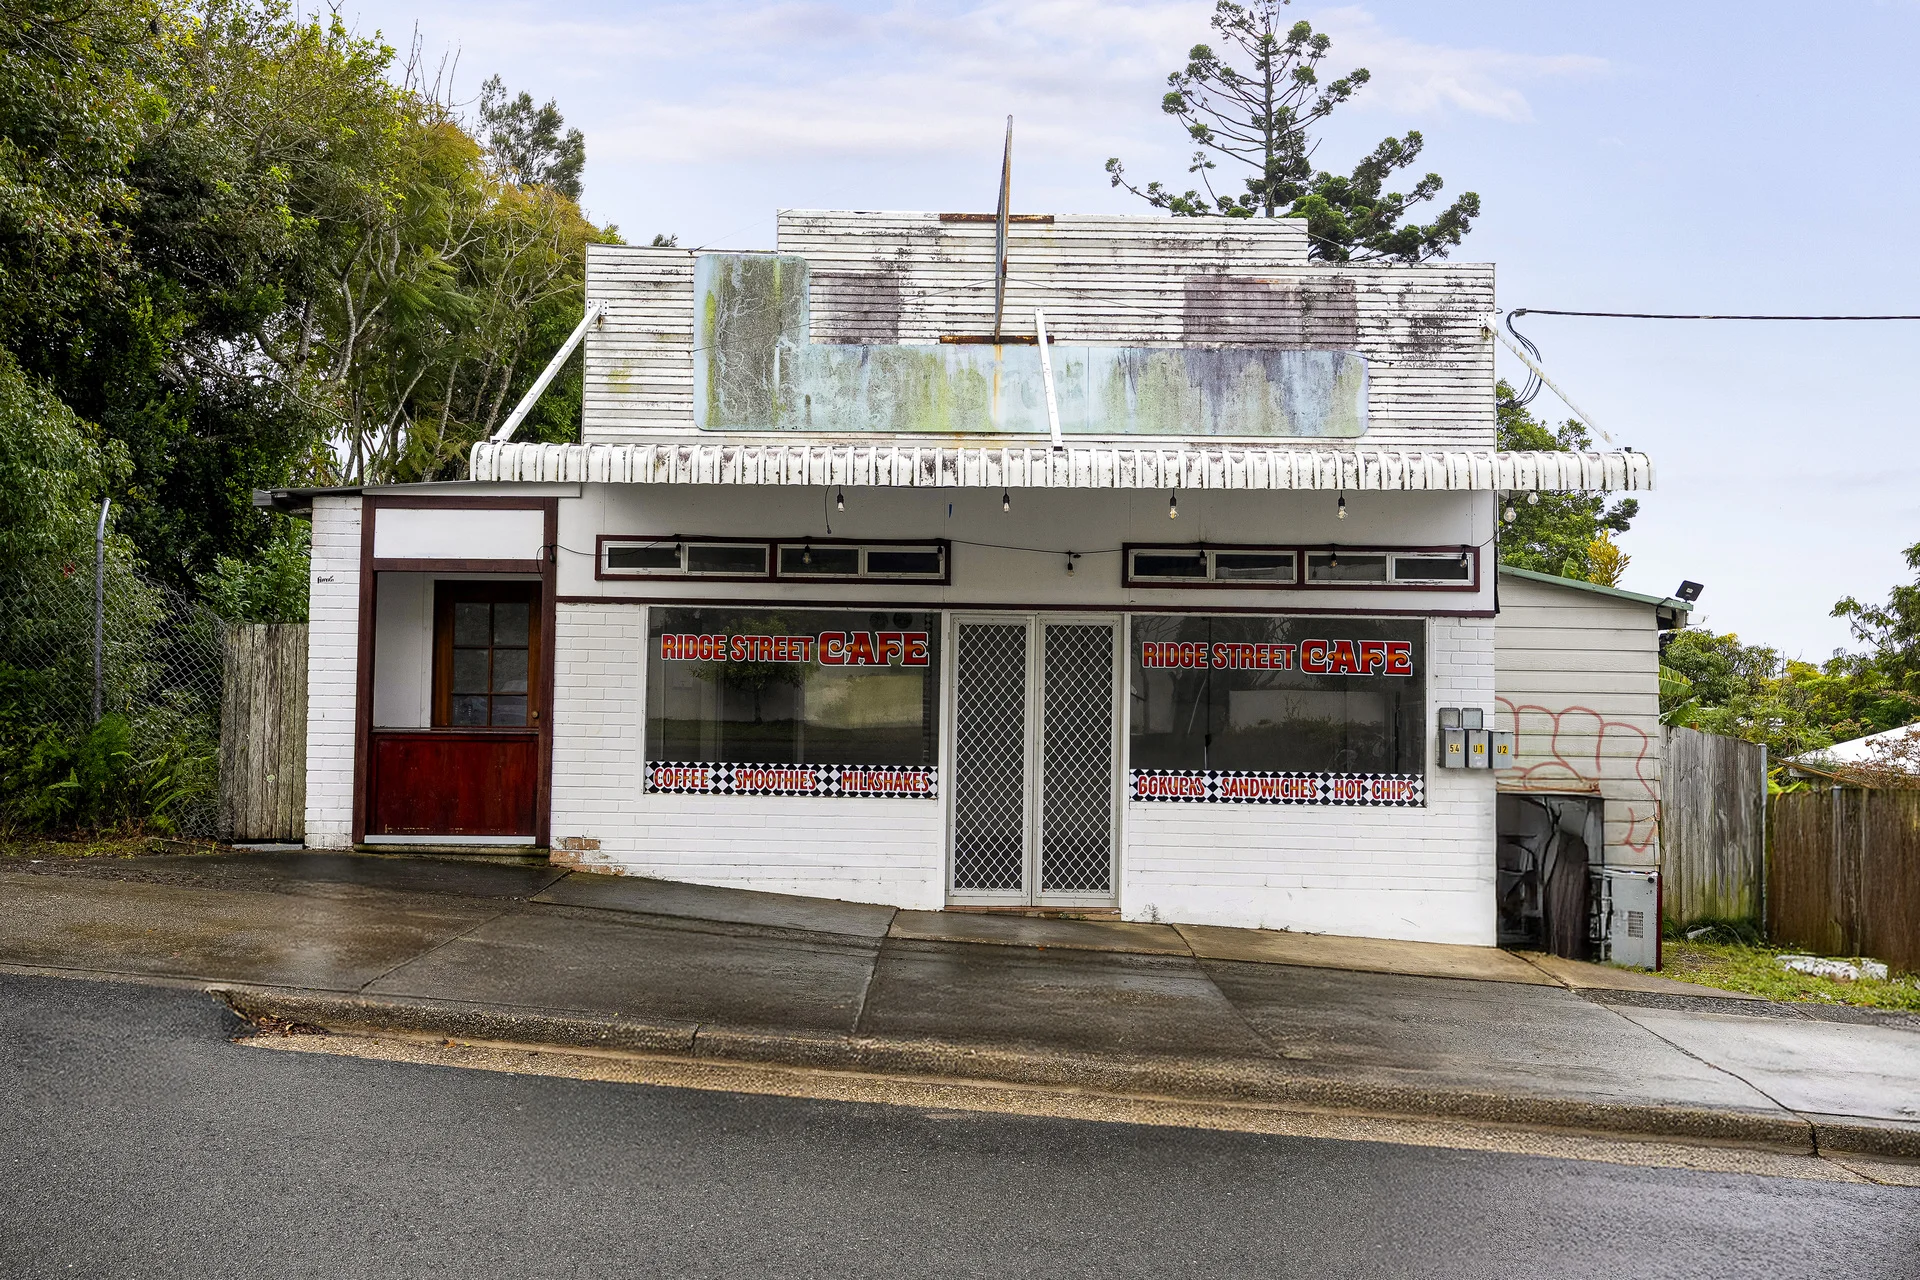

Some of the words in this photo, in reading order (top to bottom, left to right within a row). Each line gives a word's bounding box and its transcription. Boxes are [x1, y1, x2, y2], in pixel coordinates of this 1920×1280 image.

[661, 634, 727, 661] RIDGE
[730, 635, 814, 662] STREET
[818, 631, 929, 667] CAFE
[1142, 641, 1209, 669] RIDGE
[1211, 642, 1297, 670] STREET
[1300, 639, 1413, 676] CAFE
[1449, 744, 1460, 753] 54
[1473, 744, 1484, 753] U1
[1497, 745, 1508, 754] U2
[653, 767, 709, 788] COFFEE
[734, 769, 817, 790] SMOOTHIES
[841, 770, 930, 792] MILKSHAKES
[1221, 777, 1317, 798] SANDWICHES
[1333, 778, 1363, 799] HOT
[1371, 780, 1414, 801] CHIPS
